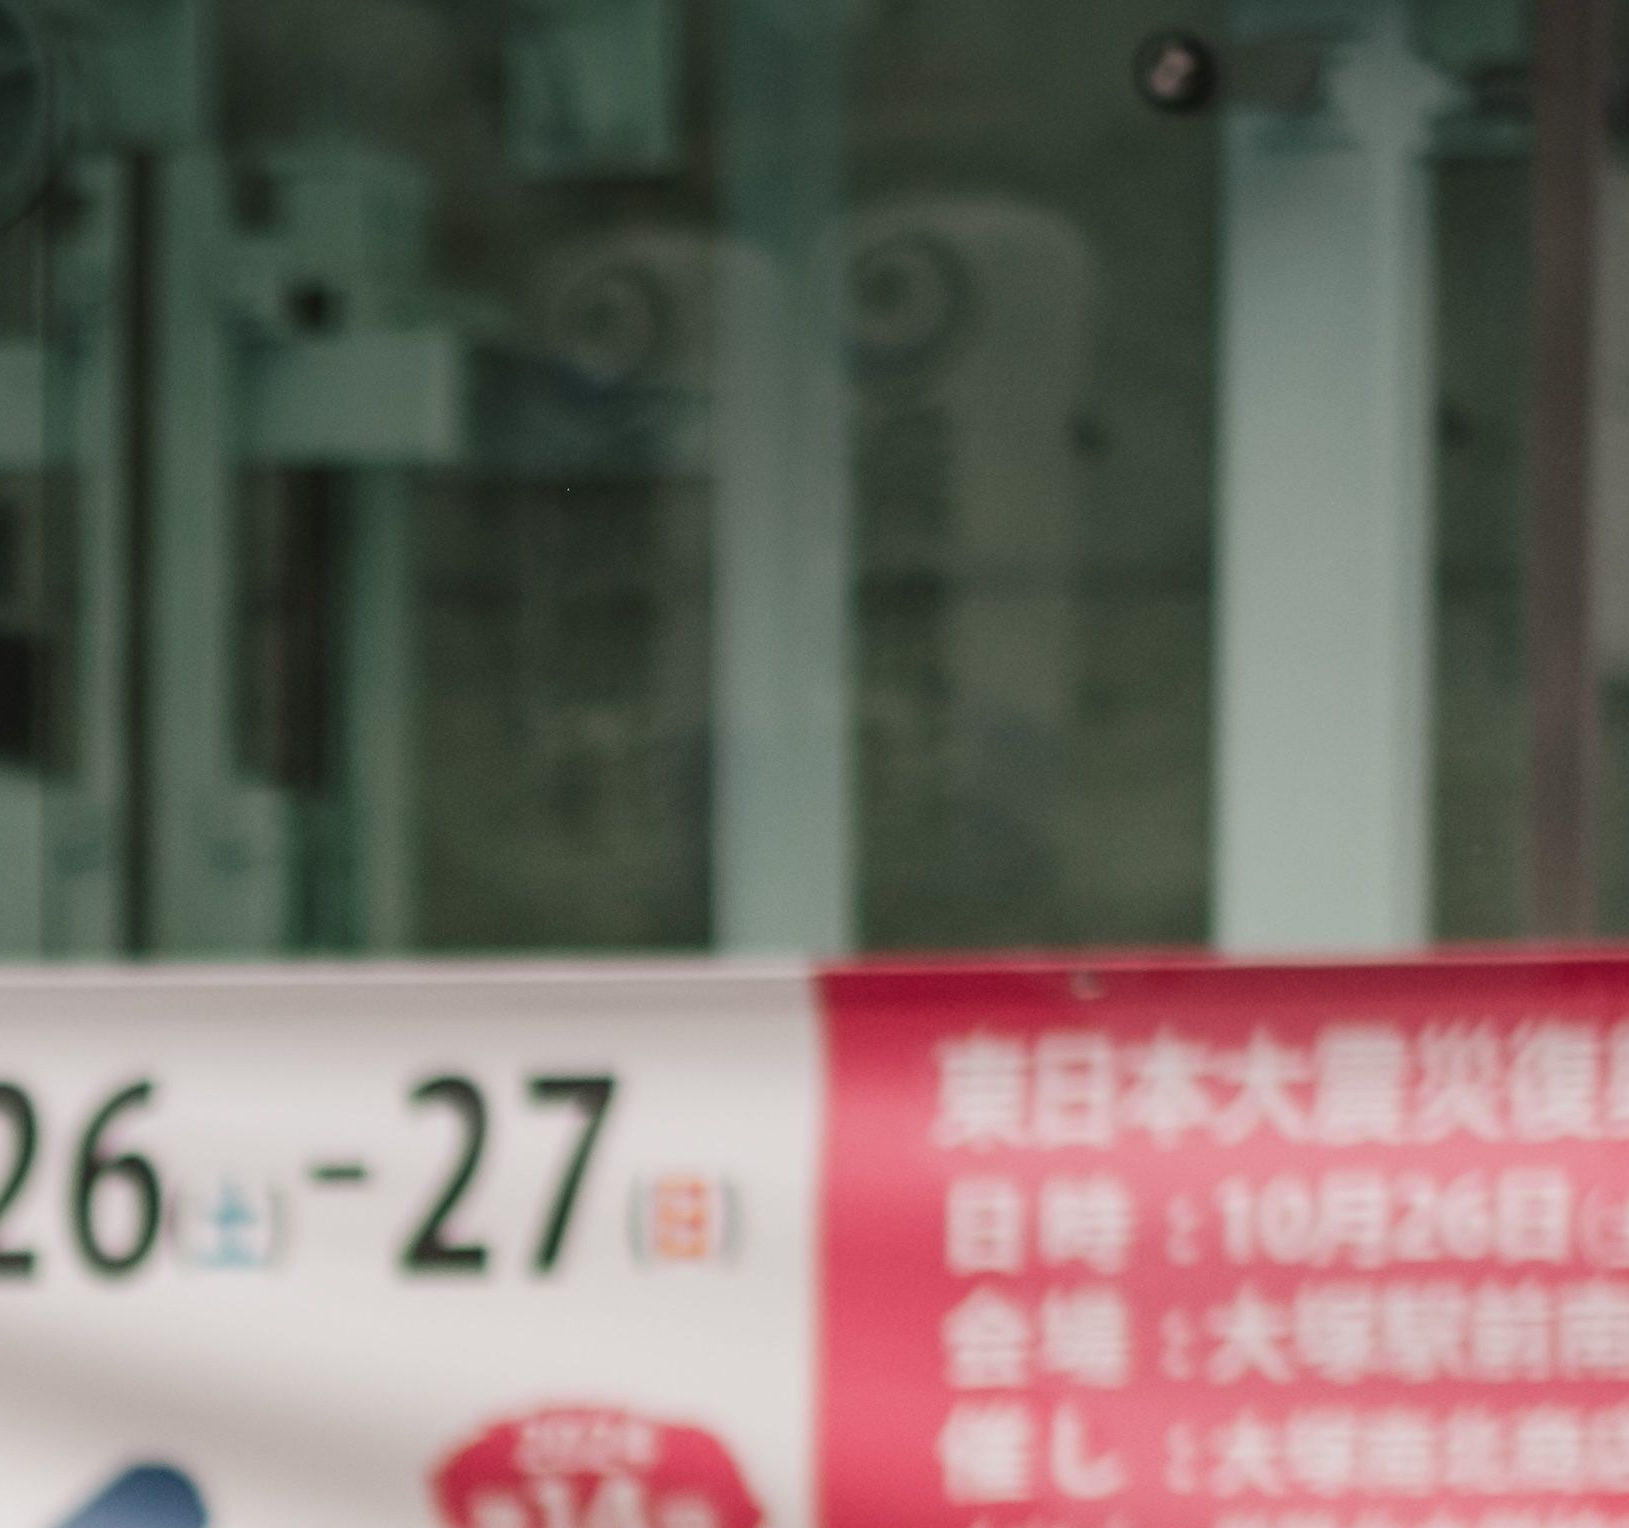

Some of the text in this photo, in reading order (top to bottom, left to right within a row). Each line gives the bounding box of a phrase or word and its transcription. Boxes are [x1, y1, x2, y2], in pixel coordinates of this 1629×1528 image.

[931, 1017, 1629, 1153] 東日本大震災復
